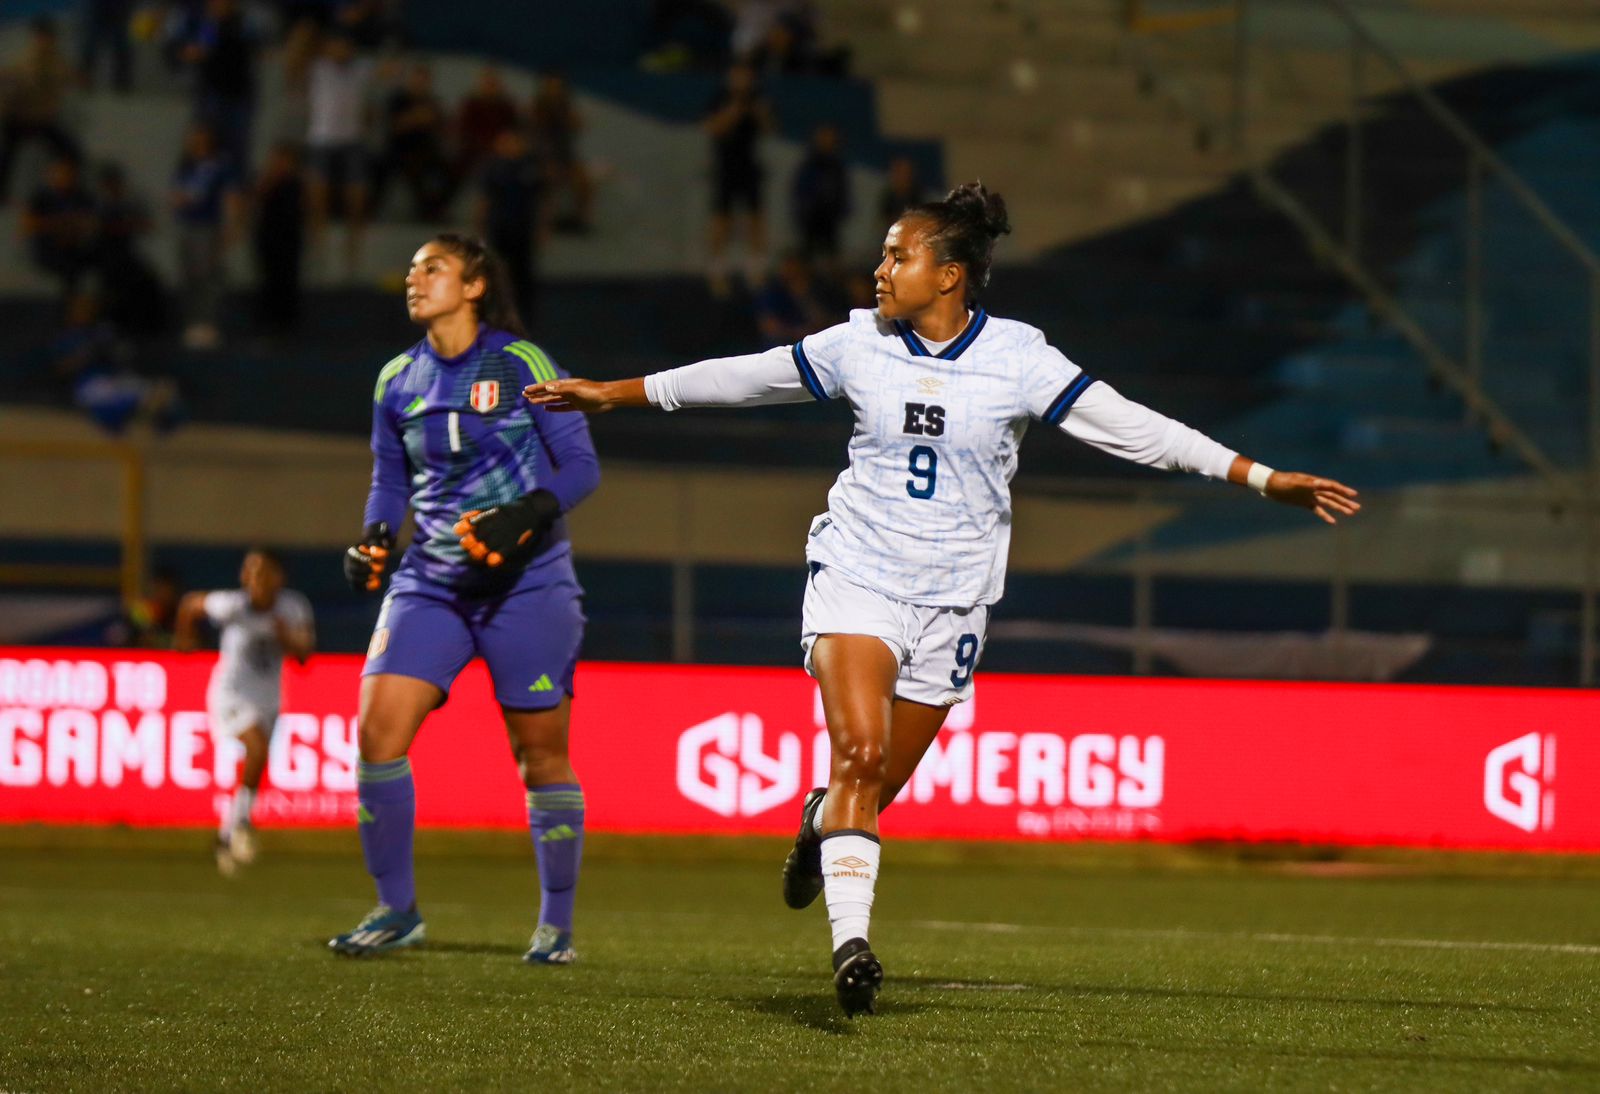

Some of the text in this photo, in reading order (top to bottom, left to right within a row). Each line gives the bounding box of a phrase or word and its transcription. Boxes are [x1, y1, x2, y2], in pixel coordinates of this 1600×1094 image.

[447, 411, 461, 452] 1
[903, 402, 945, 437] ES
[906, 444, 938, 500] 9
[950, 633, 979, 688] 9
[813, 731, 1165, 808] MERGY
